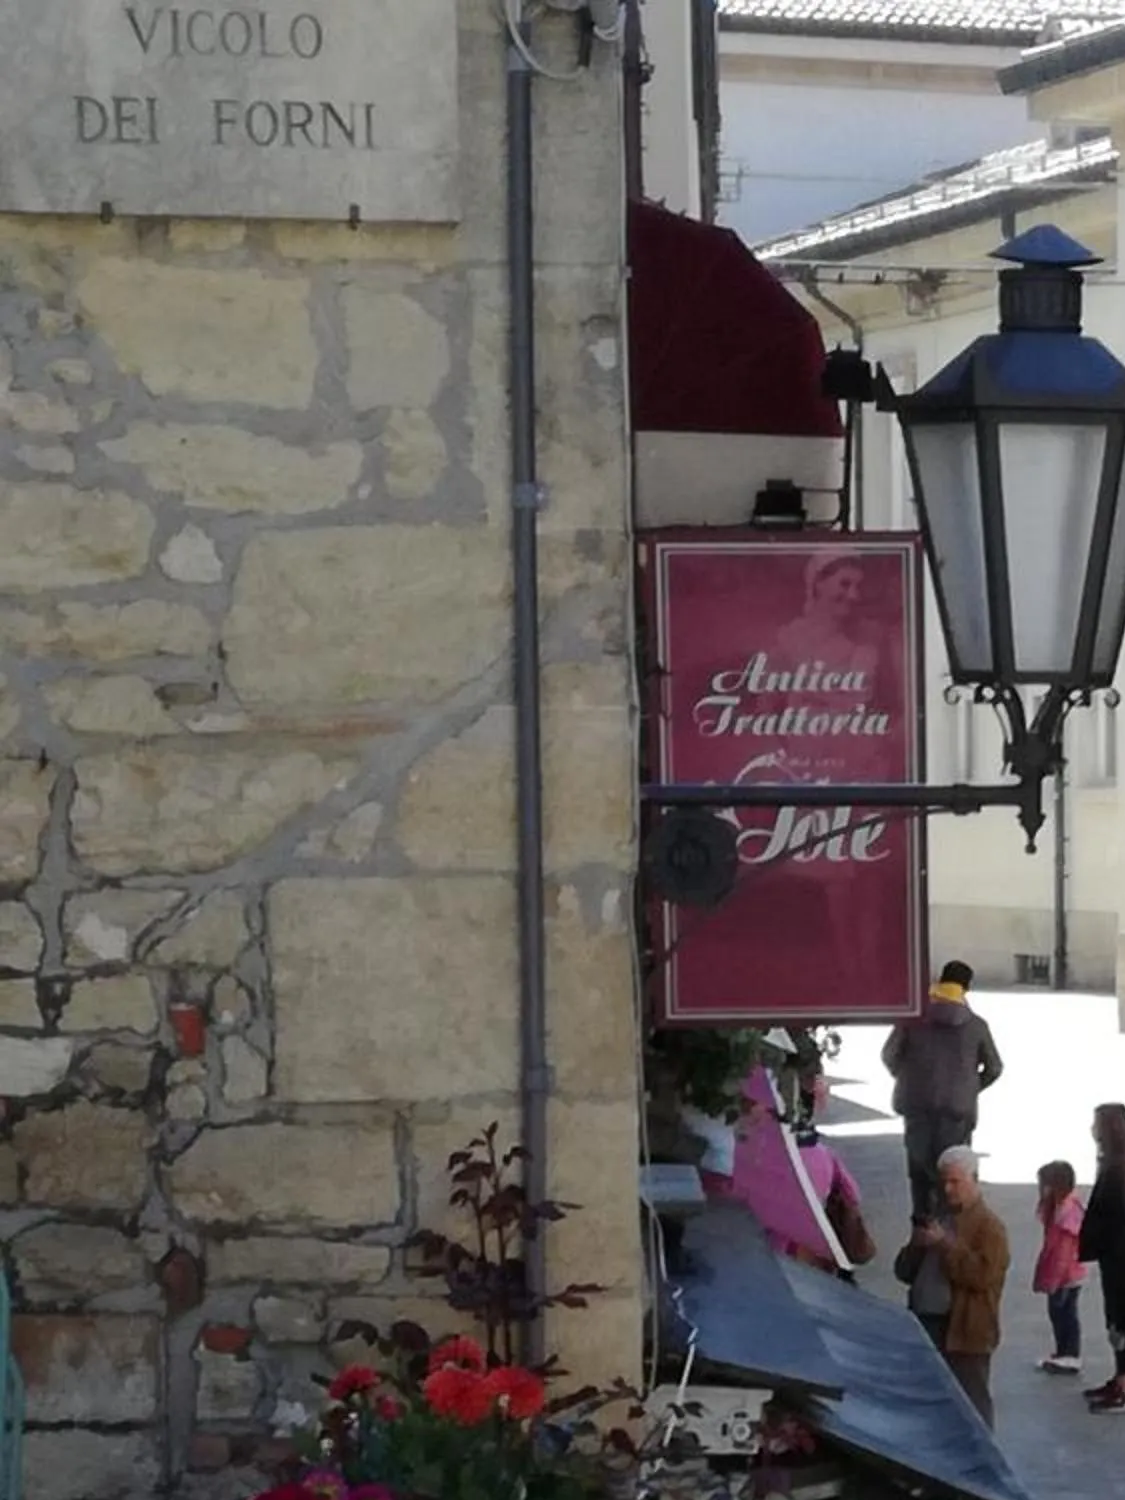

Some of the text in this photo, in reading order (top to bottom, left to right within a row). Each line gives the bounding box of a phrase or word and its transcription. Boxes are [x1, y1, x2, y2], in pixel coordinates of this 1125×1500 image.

[123, 7, 324, 60] VICOLO
[73, 95, 376, 151] DEI FORNI
[710, 651, 868, 693] Antica
[692, 695, 892, 737] Trattoria
